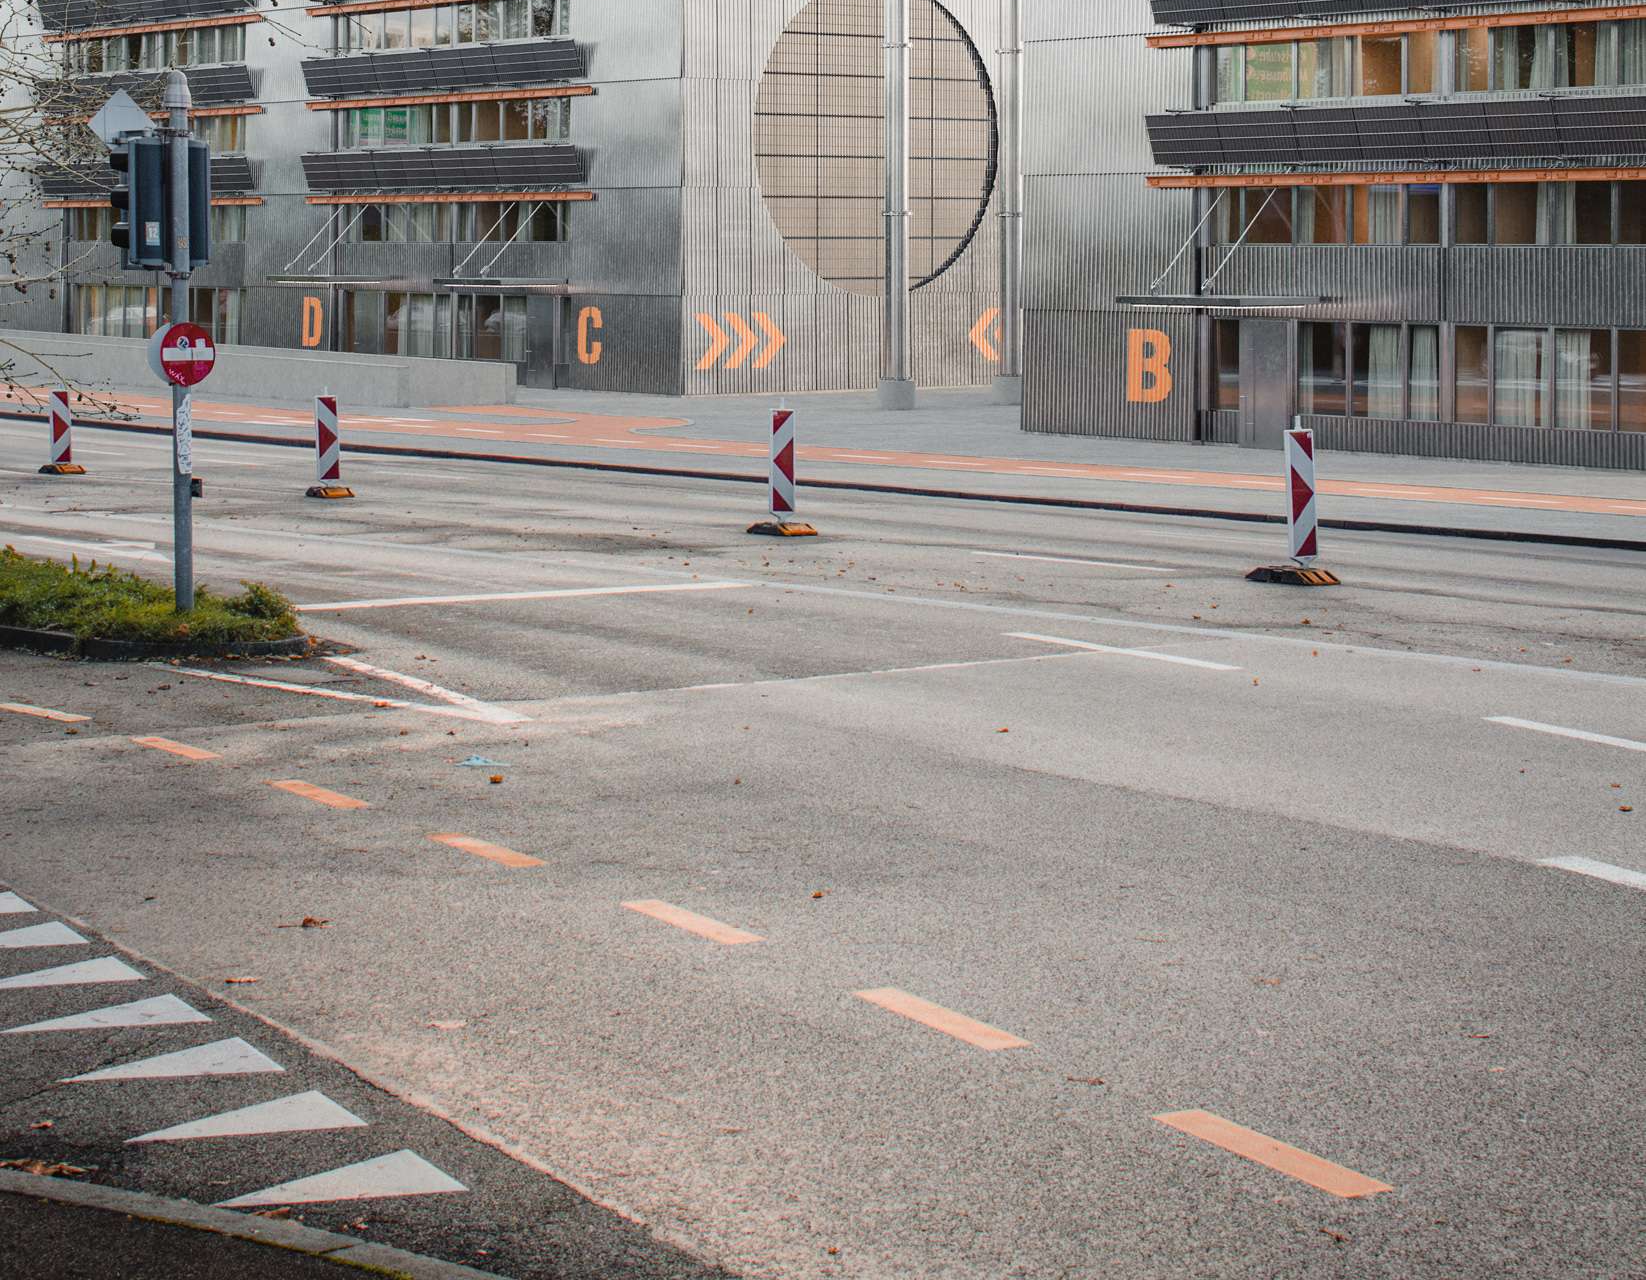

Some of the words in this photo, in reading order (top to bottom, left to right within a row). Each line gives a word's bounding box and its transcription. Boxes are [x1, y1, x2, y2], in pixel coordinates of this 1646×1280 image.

[302, 296, 323, 347] D
[577, 306, 603, 365] C
[1126, 328, 1173, 403] B
